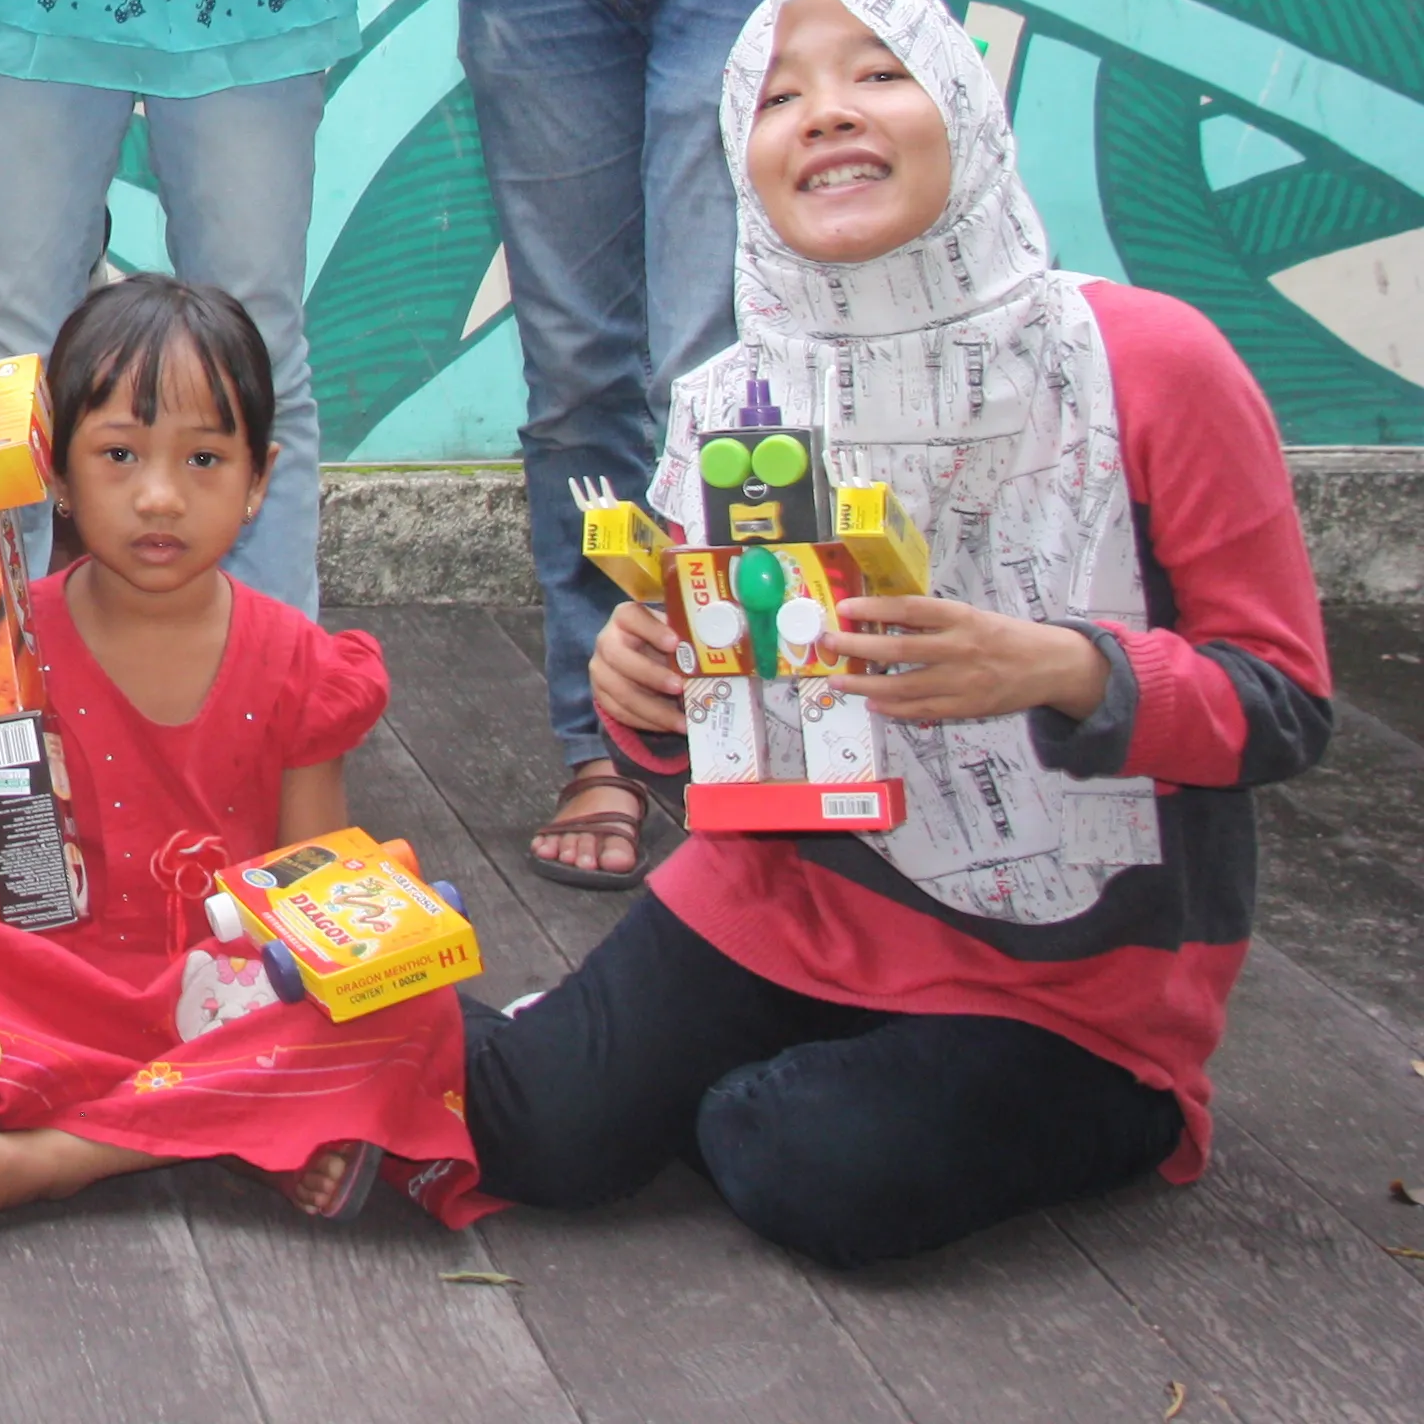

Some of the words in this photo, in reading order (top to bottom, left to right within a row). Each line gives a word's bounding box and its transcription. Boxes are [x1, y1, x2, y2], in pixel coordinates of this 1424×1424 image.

[839, 503, 852, 531] UHU
[586, 523, 599, 551] UHU
[288, 893, 353, 946] DRAGON
[335, 973, 383, 996] DRAGON
[383, 954, 435, 984] MENTHOL
[348, 987, 385, 1005] CONTENT
[398, 971, 428, 988] DOZEN
